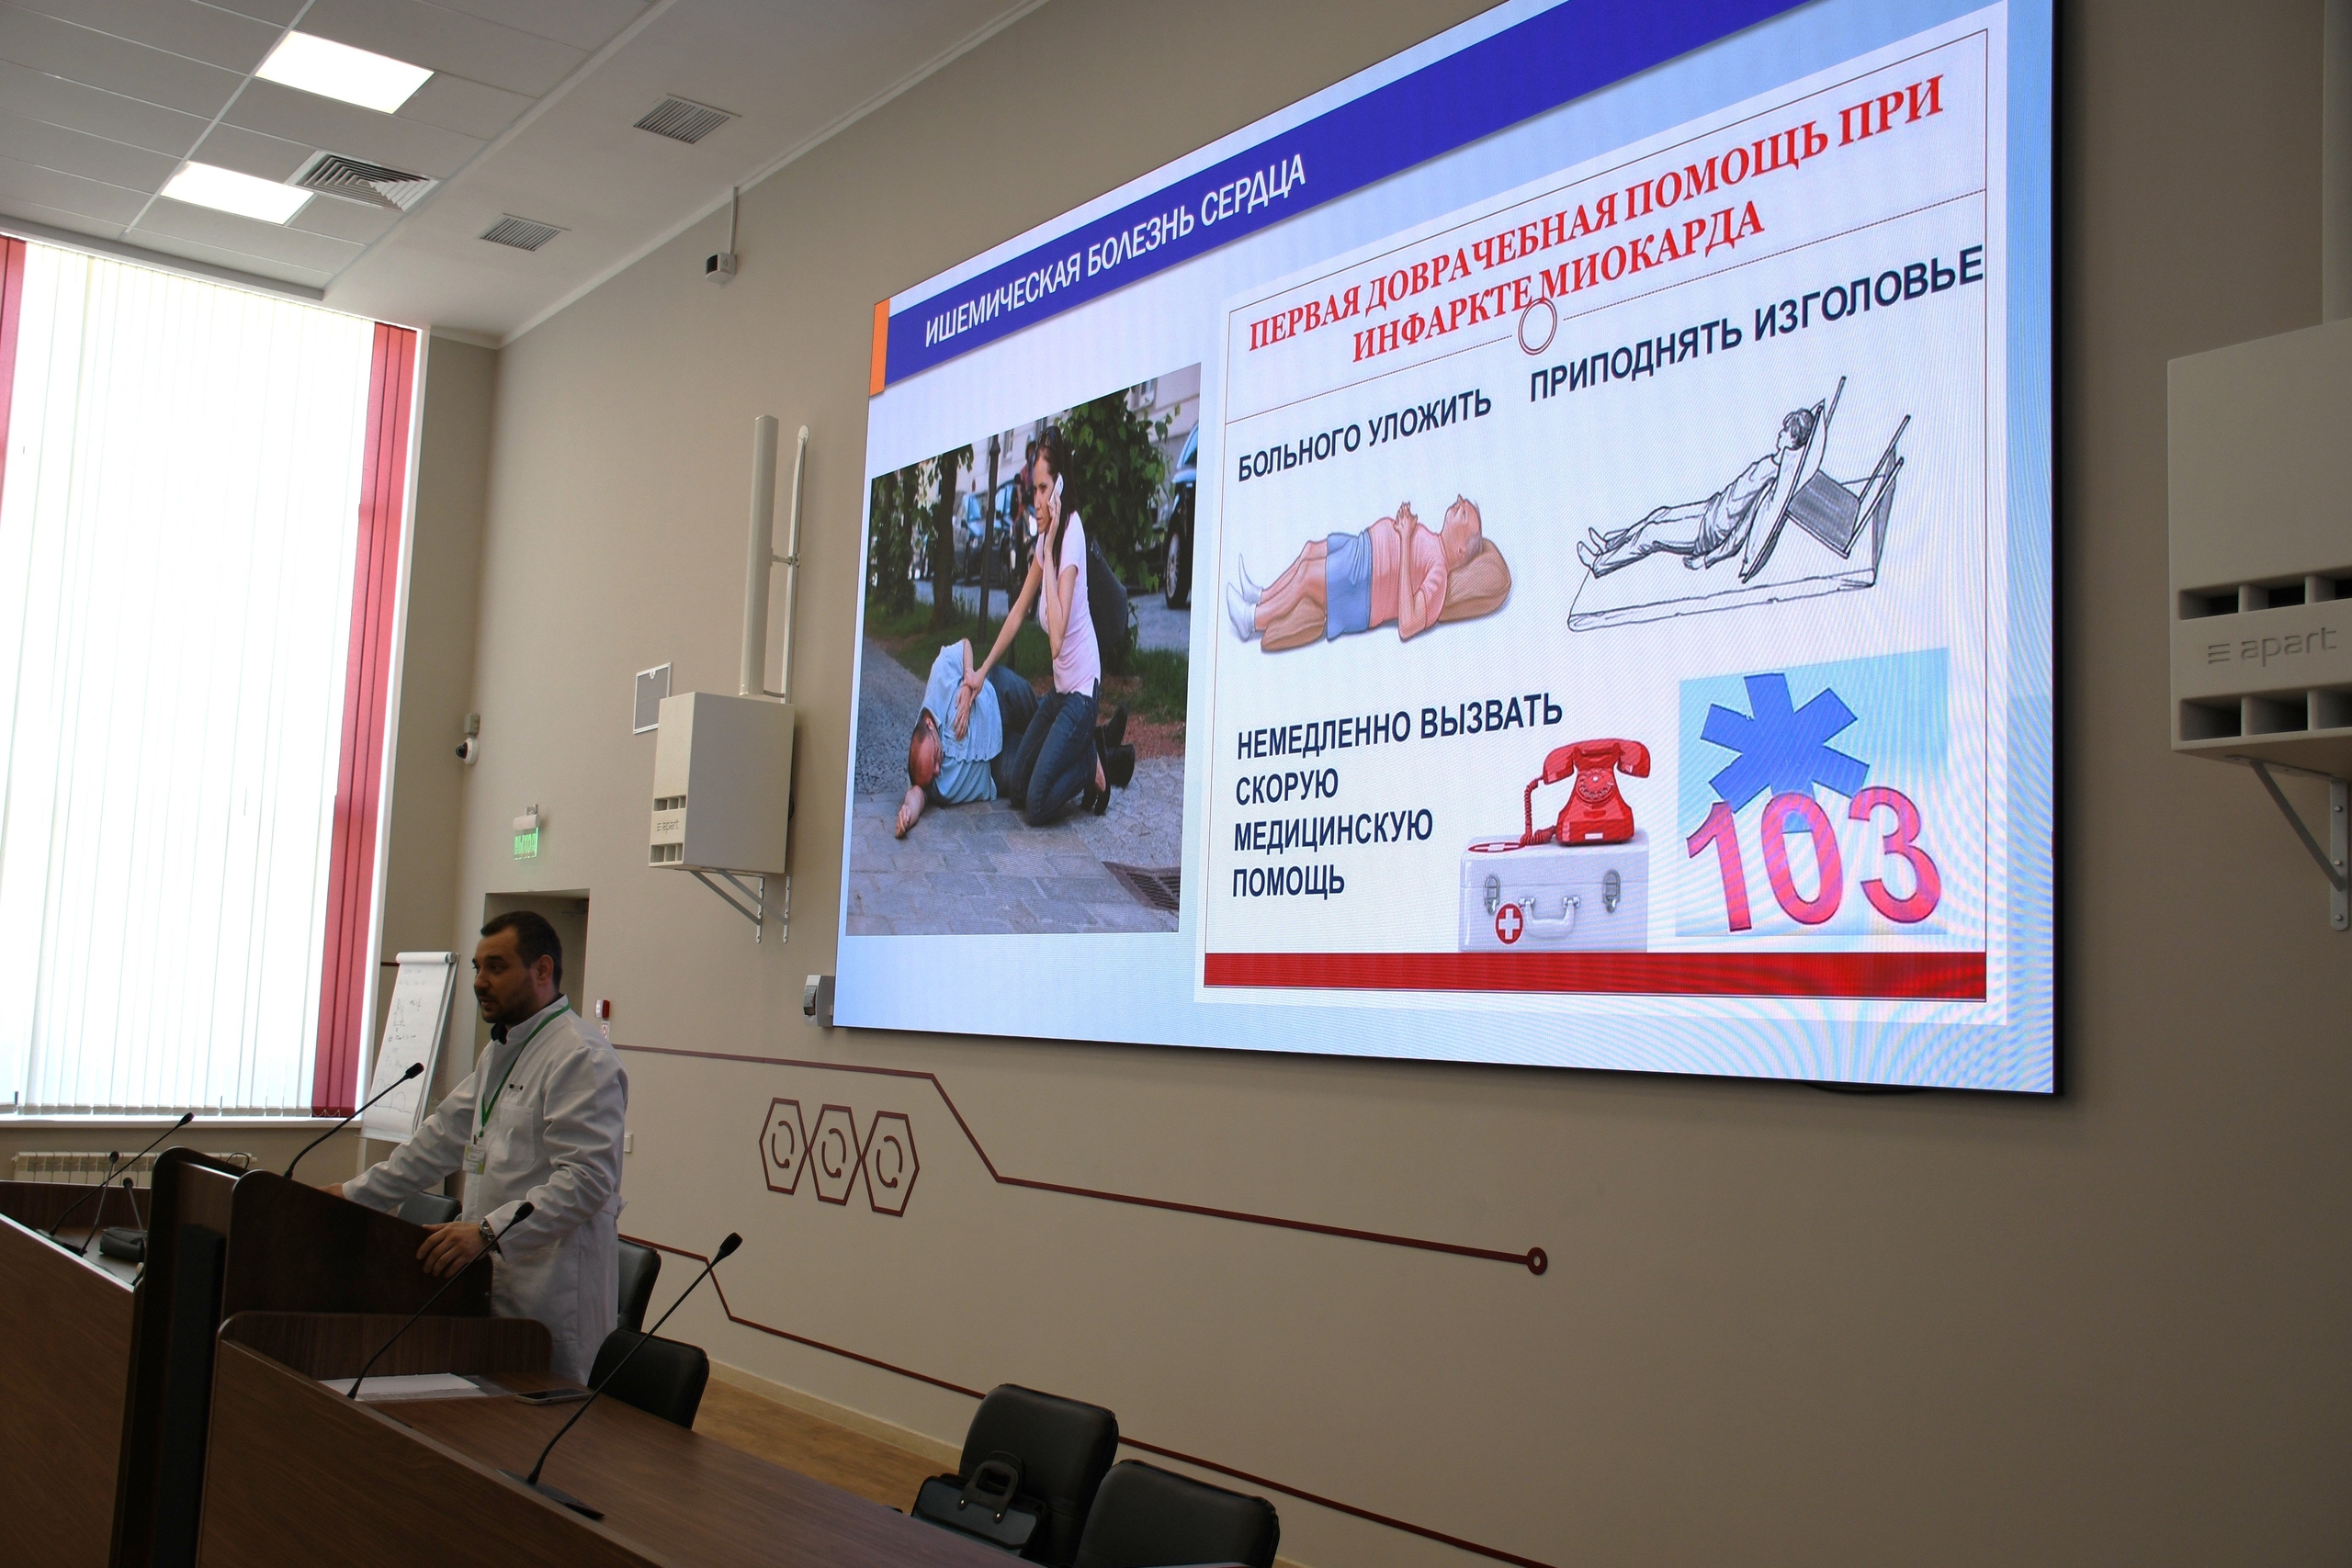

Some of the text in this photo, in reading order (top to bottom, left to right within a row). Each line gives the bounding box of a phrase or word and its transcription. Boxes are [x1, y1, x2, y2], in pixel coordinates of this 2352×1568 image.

[924, 153, 1306, 348] ИШЕМИЧЕСКАЯ БОЛЕЗНЬ СЕРДЦА
[1249, 74, 1945, 352] ПЕРВАЯ ДОВРАЧЕБНАЯ ПОМОЩЬ ПРИ
[1351, 200, 1765, 364] ИНФАРКТЕ МИОКАРДА
[1530, 244, 1984, 403] ПРИПОДНЯТЬ ИЗГОЛОВЬЕ
[1238, 389, 1492, 482] БОЛЬНОГО УЛОЖИТЬ
[2240, 626, 2337, 668] apart
[1237, 692, 1564, 761] НЕМЕДЛЕННО ВЫЗВАТЬ
[1234, 808, 1434, 855] МЕДИЦИНСКУЮ
[1235, 768, 1340, 807] СКОРУЮ
[1232, 864, 1346, 900] ПОМОЩЬ
[1687, 787, 1945, 933] 103
